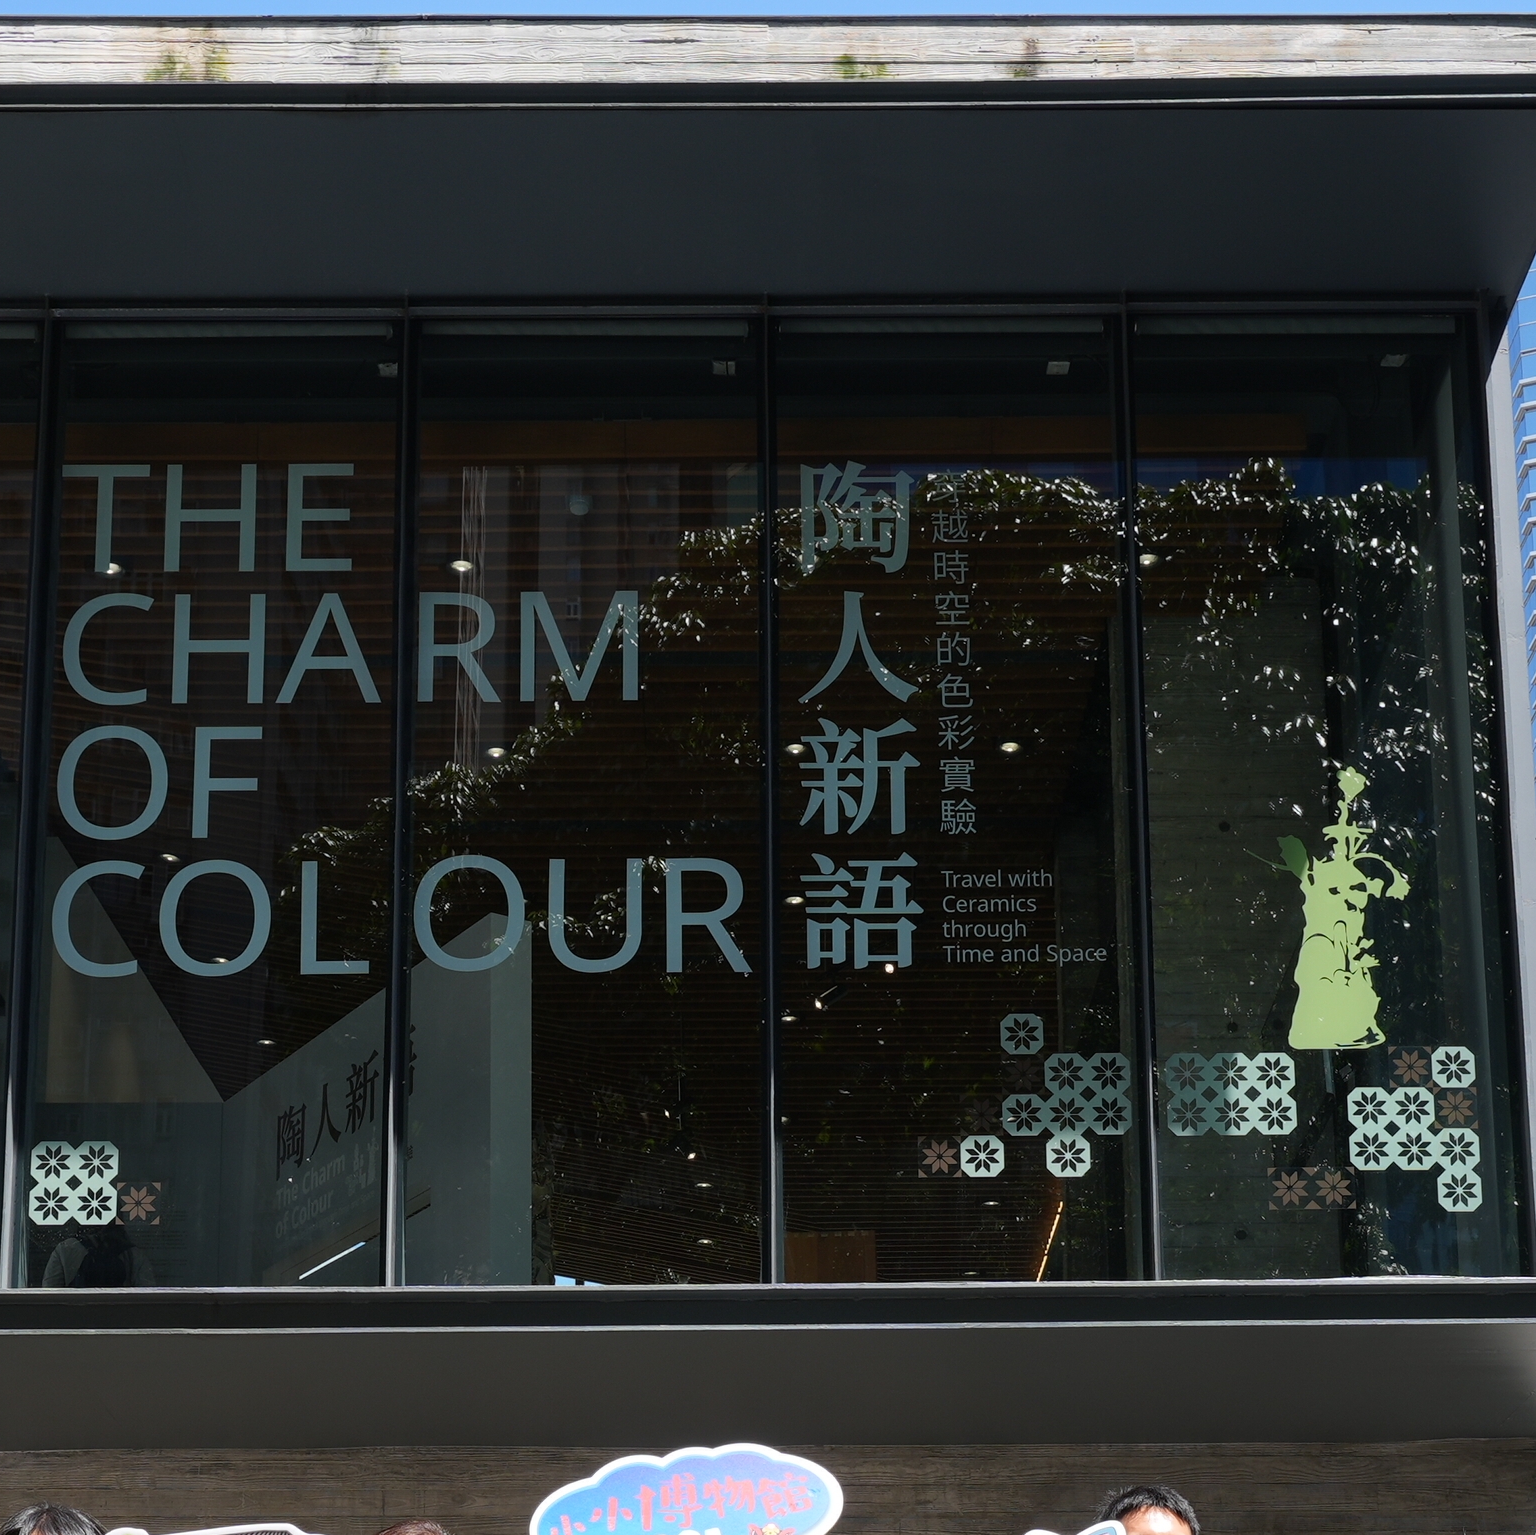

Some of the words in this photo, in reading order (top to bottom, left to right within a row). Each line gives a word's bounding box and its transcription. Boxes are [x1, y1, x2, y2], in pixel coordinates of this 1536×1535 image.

[62, 463, 354, 572] THE
[63, 590, 639, 706] CHARM
[929, 467, 977, 835] 穿越時空的色彩實驗
[798, 460, 924, 970] 陶人新語
[57, 725, 263, 841] OF
[51, 854, 753, 978] COLOUR
[941, 870, 1002, 888] Travel
[1008, 868, 1053, 887] with
[942, 894, 1037, 914] Ceramics
[942, 919, 1027, 943] through
[942, 944, 995, 963] Time
[1000, 944, 1040, 963] and
[1046, 944, 1107, 968] Space
[275, 1183, 299, 1211] The
[302, 1153, 346, 1195] Charm
[275, 1214, 289, 1239] of
[291, 1189, 334, 1229] Colour
